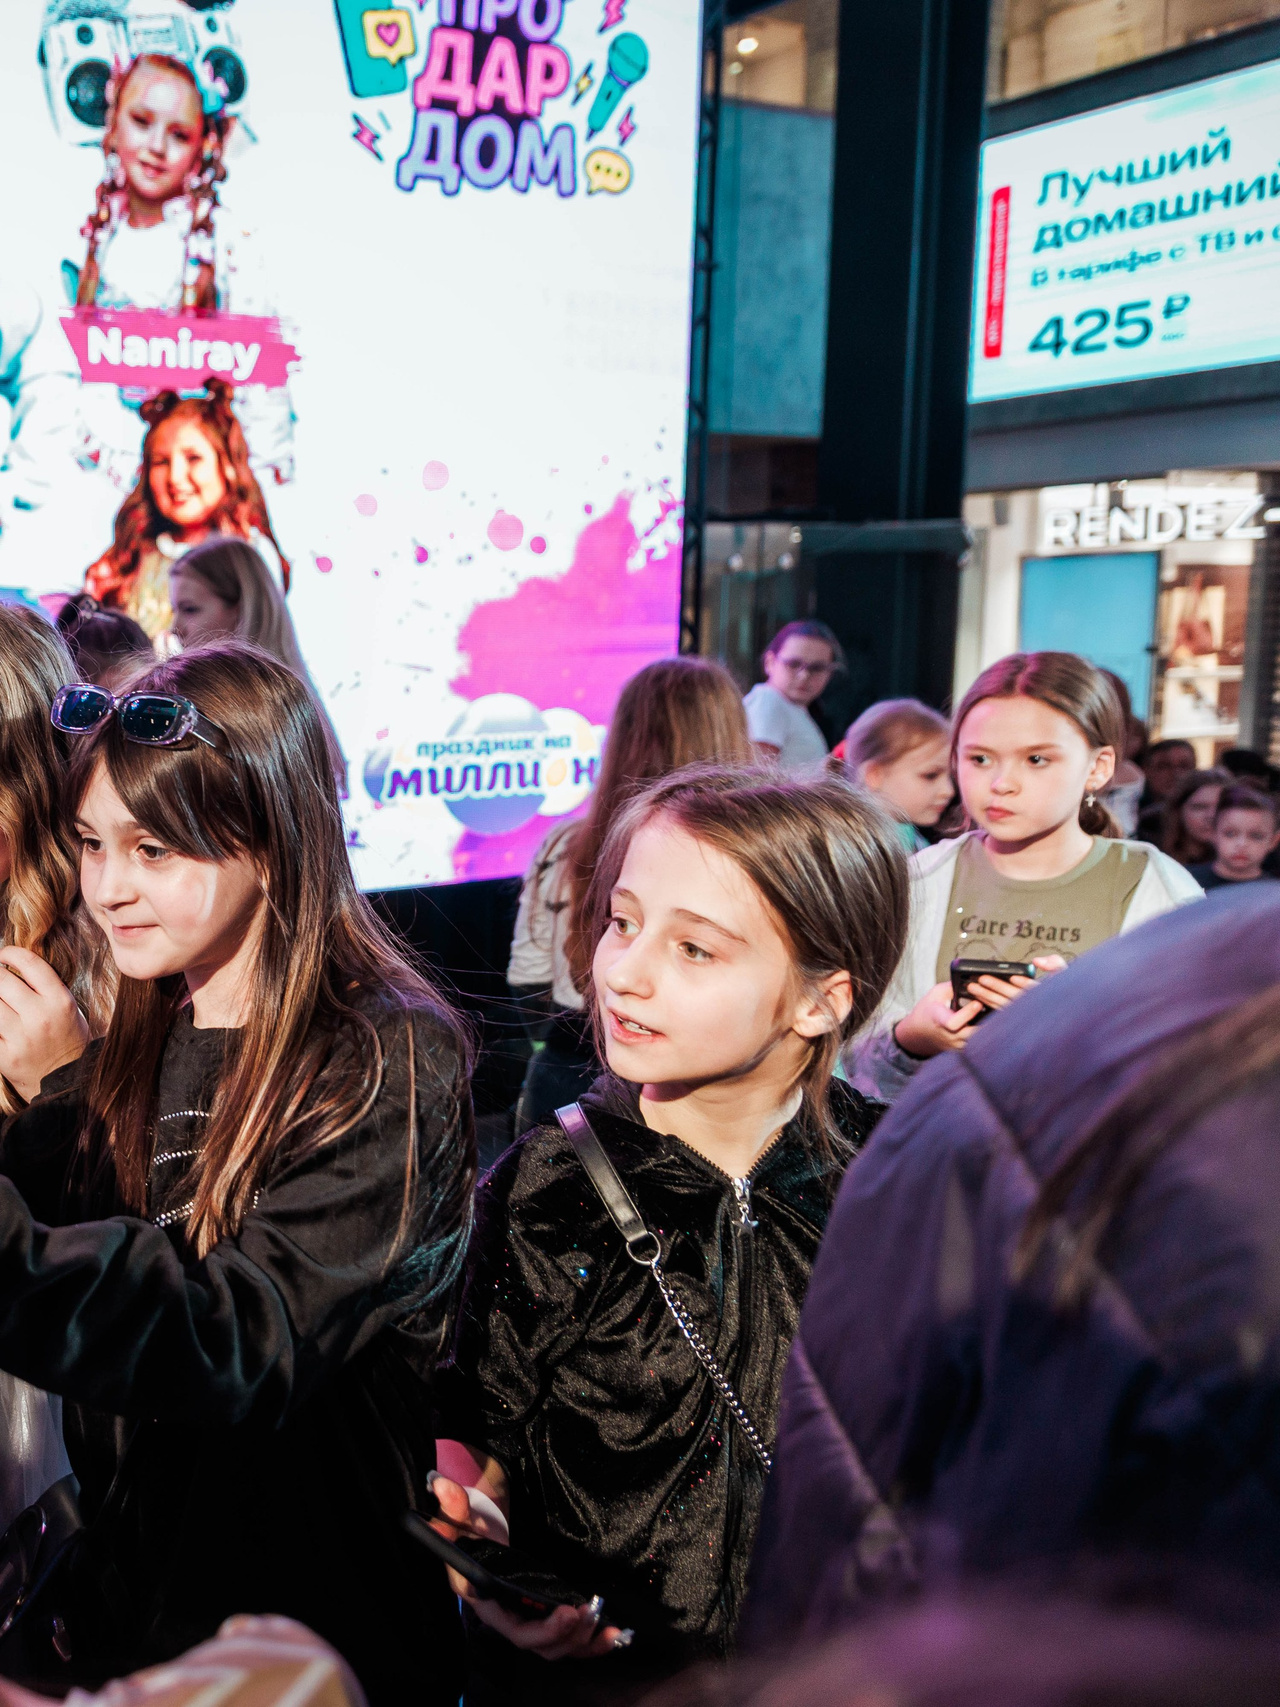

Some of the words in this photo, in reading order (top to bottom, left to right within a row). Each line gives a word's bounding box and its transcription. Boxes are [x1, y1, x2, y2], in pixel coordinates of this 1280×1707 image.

[414, 27, 571, 117] ДАР
[396, 108, 577, 197] ДОМ
[1036, 126, 1232, 207] Лучший
[1197, 230, 1236, 254] ТВ
[85, 325, 262, 381] Naniray
[1027, 299, 1154, 358] 425
[960, 915, 1008, 936] Care
[1013, 919, 1081, 943] Bears
